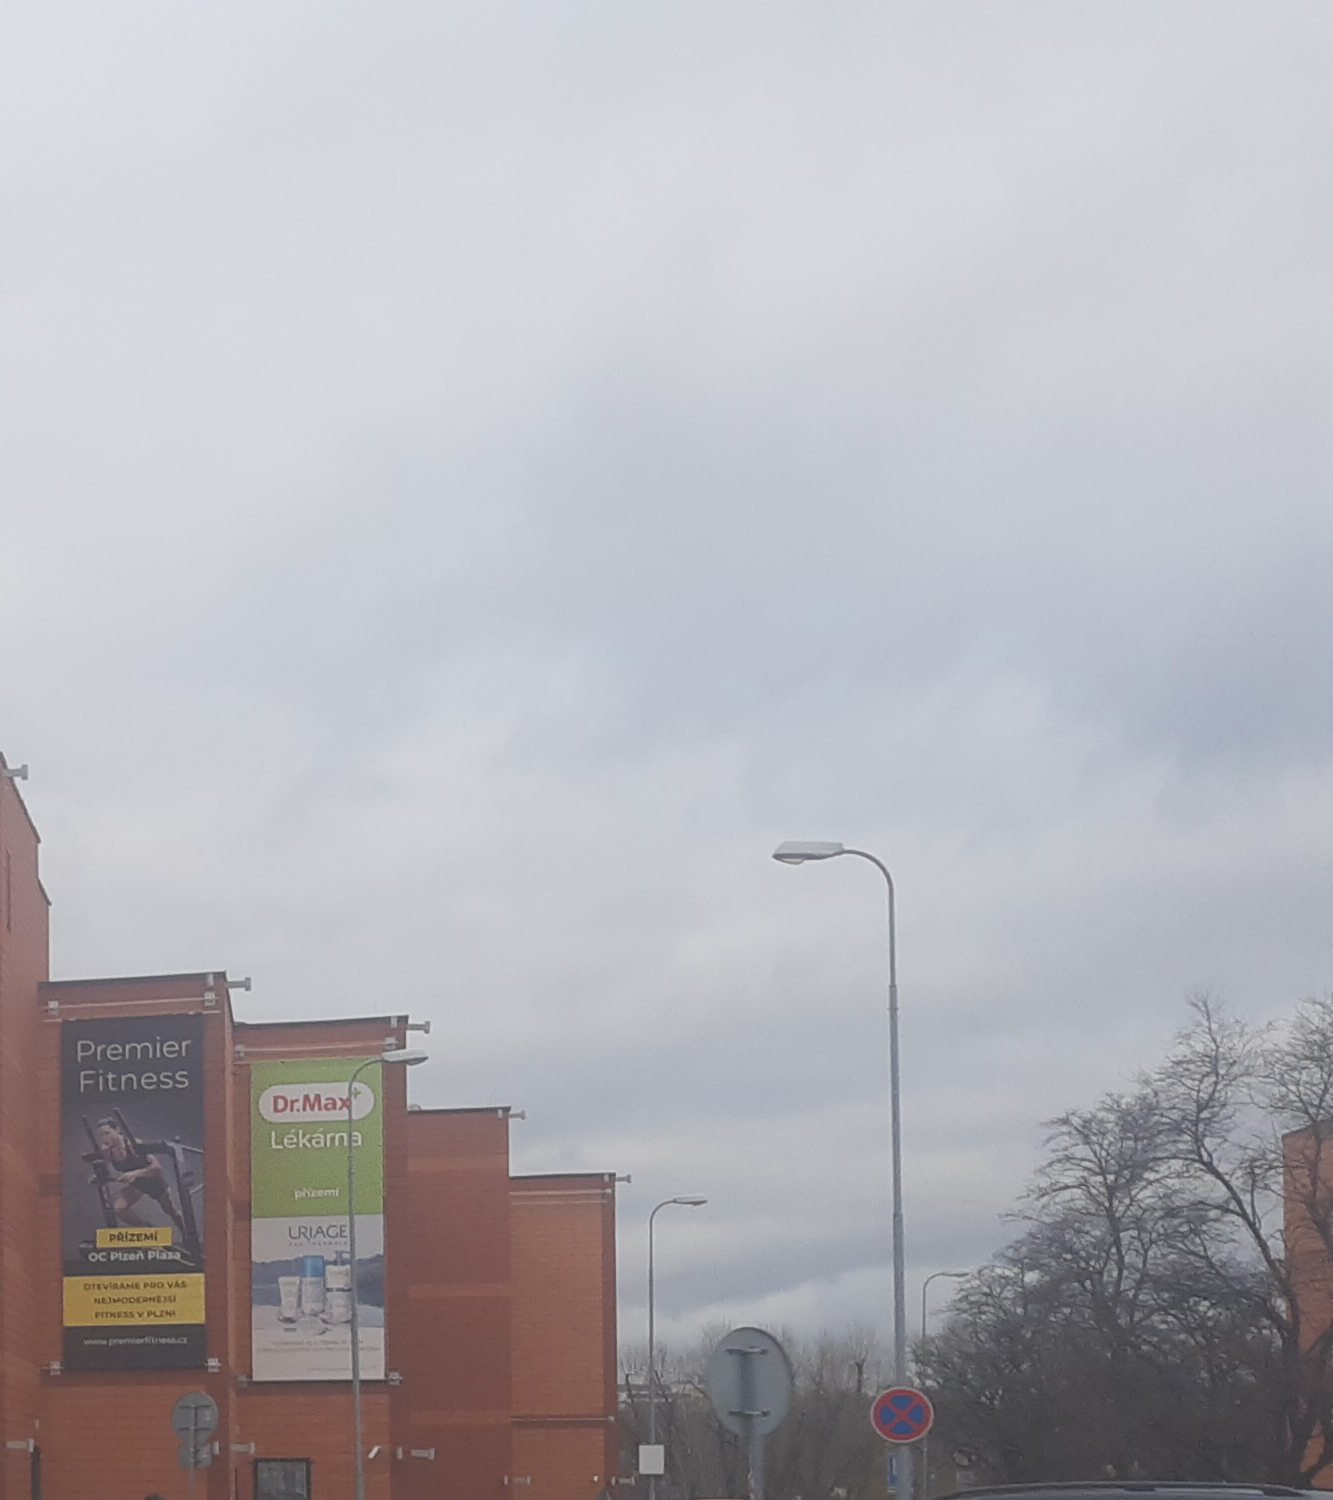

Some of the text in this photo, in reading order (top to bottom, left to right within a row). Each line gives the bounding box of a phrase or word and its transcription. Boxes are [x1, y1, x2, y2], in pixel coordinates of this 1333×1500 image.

[76, 1035, 192, 1063] Premier
[79, 1069, 190, 1093] Fitness
[272, 1093, 351, 1114] Dr.Max
[271, 1128, 363, 1149] Lékárna
[109, 1231, 159, 1242] PŘÍZEMÍ
[288, 1224, 349, 1242] URIAGE
[88, 1250, 182, 1262] OC Plzeň Plaza
[143, 1281, 165, 1289] PRO
[95, 1310, 135, 1319] FITNESS
[136, 1310, 145, 1318] V
